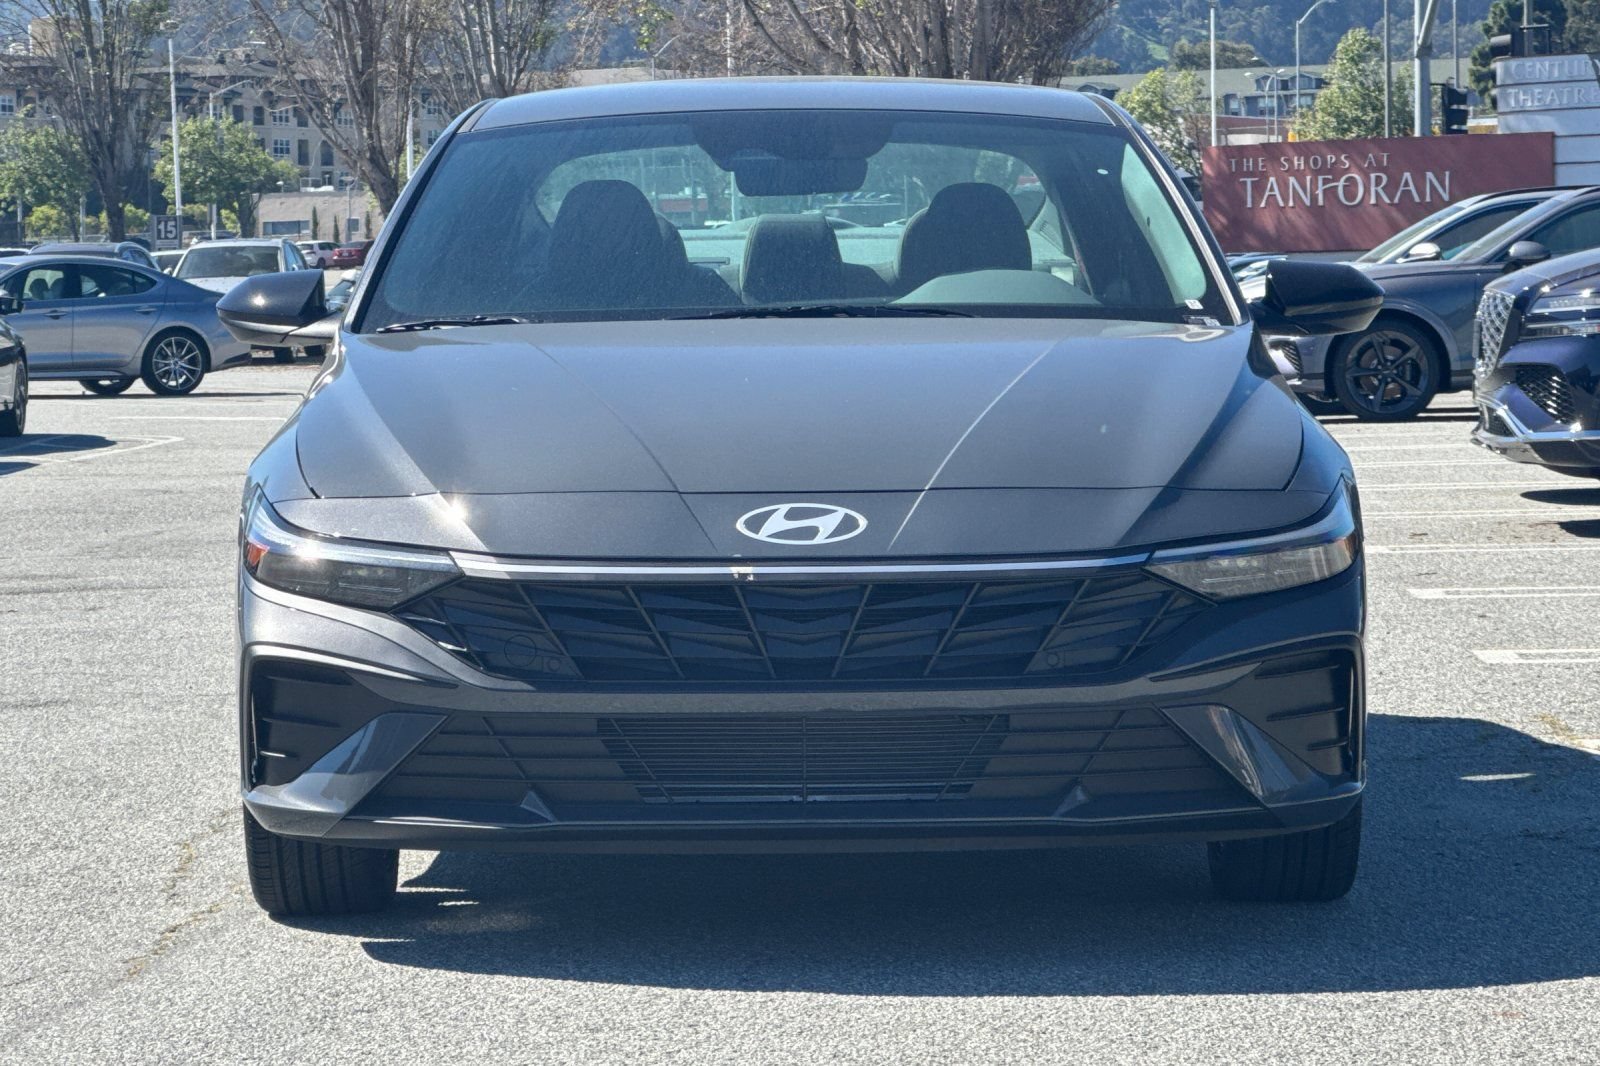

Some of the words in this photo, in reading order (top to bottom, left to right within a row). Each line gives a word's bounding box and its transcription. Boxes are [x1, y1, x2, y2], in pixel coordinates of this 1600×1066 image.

[1229, 157, 1266, 172] THE
[1280, 154, 1350, 171] SHOPS
[1364, 152, 1390, 168] AT
[1239, 171, 1450, 208] TANFORAN
[158, 221, 176, 238] 15
